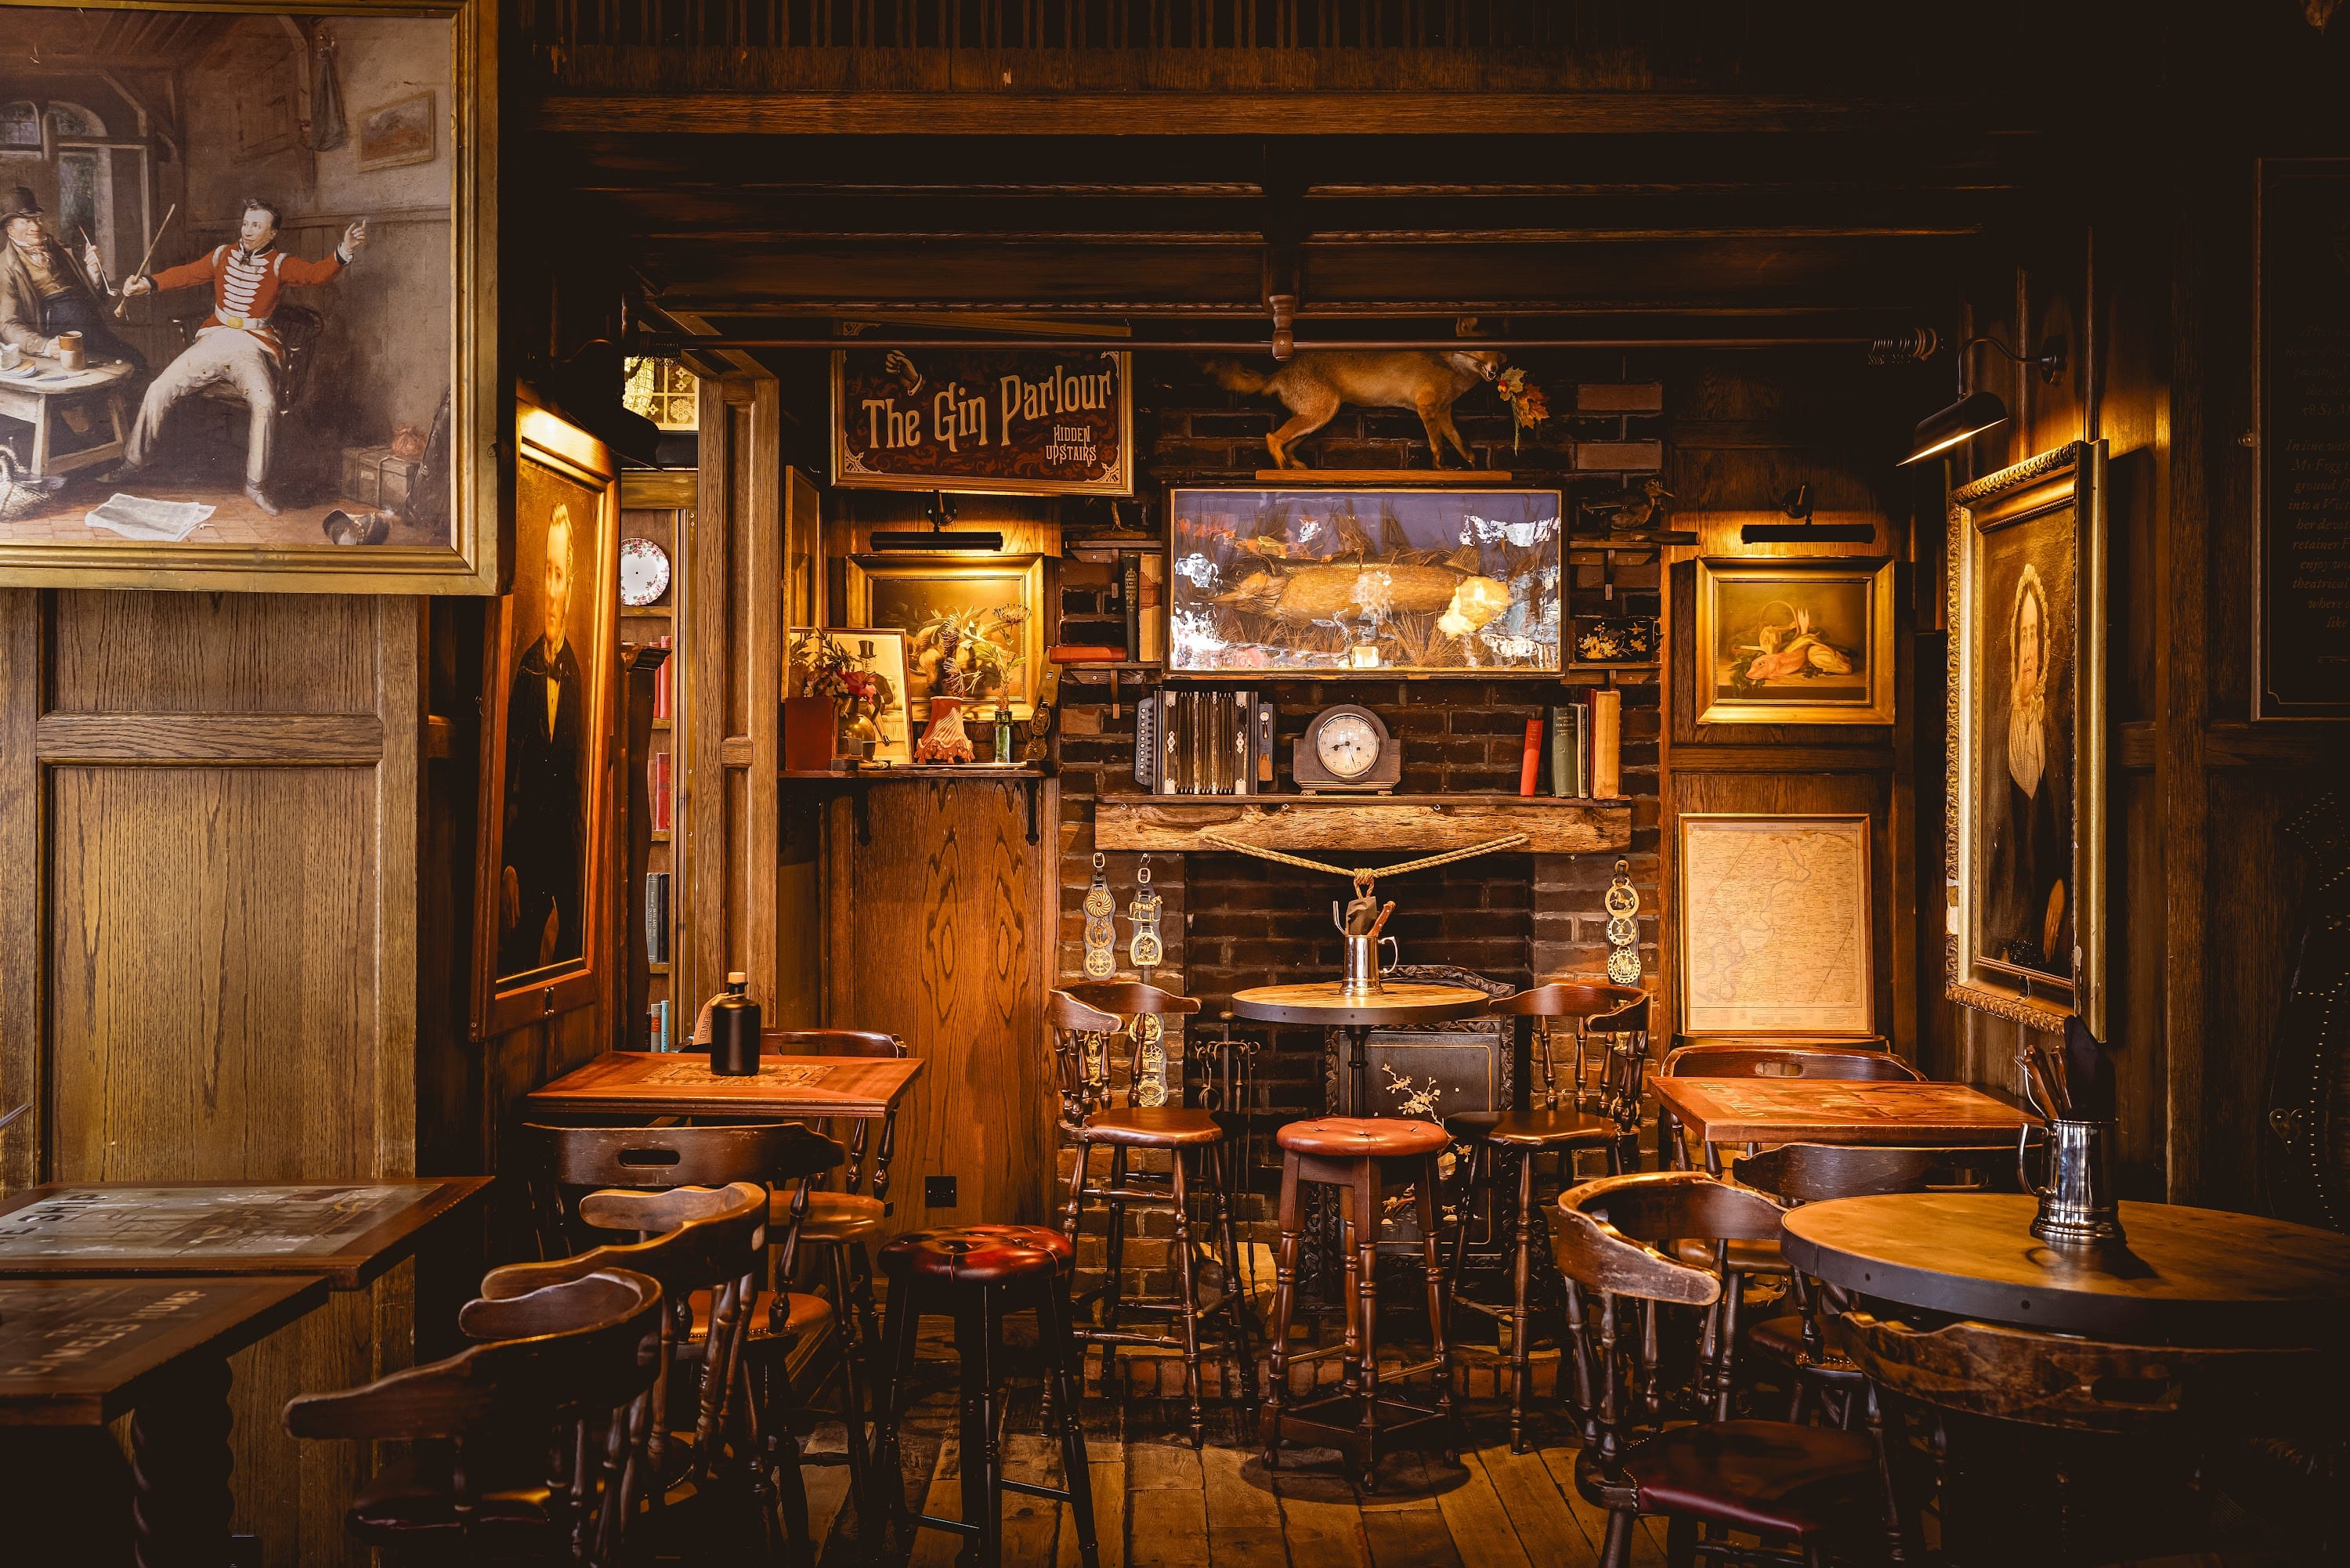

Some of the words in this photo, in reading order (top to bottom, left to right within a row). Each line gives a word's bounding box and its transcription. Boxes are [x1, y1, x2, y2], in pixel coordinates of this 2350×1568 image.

[862, 399, 920, 450] The
[934, 381, 987, 453] Gin
[1000, 364, 1112, 447] Parlour
[1054, 424, 1091, 446] HIDDEN
[1046, 444, 1097, 468] UPSTAIRS
[17, 1194, 107, 1222] SHIP
[130, 1290, 207, 1319] HUMP
